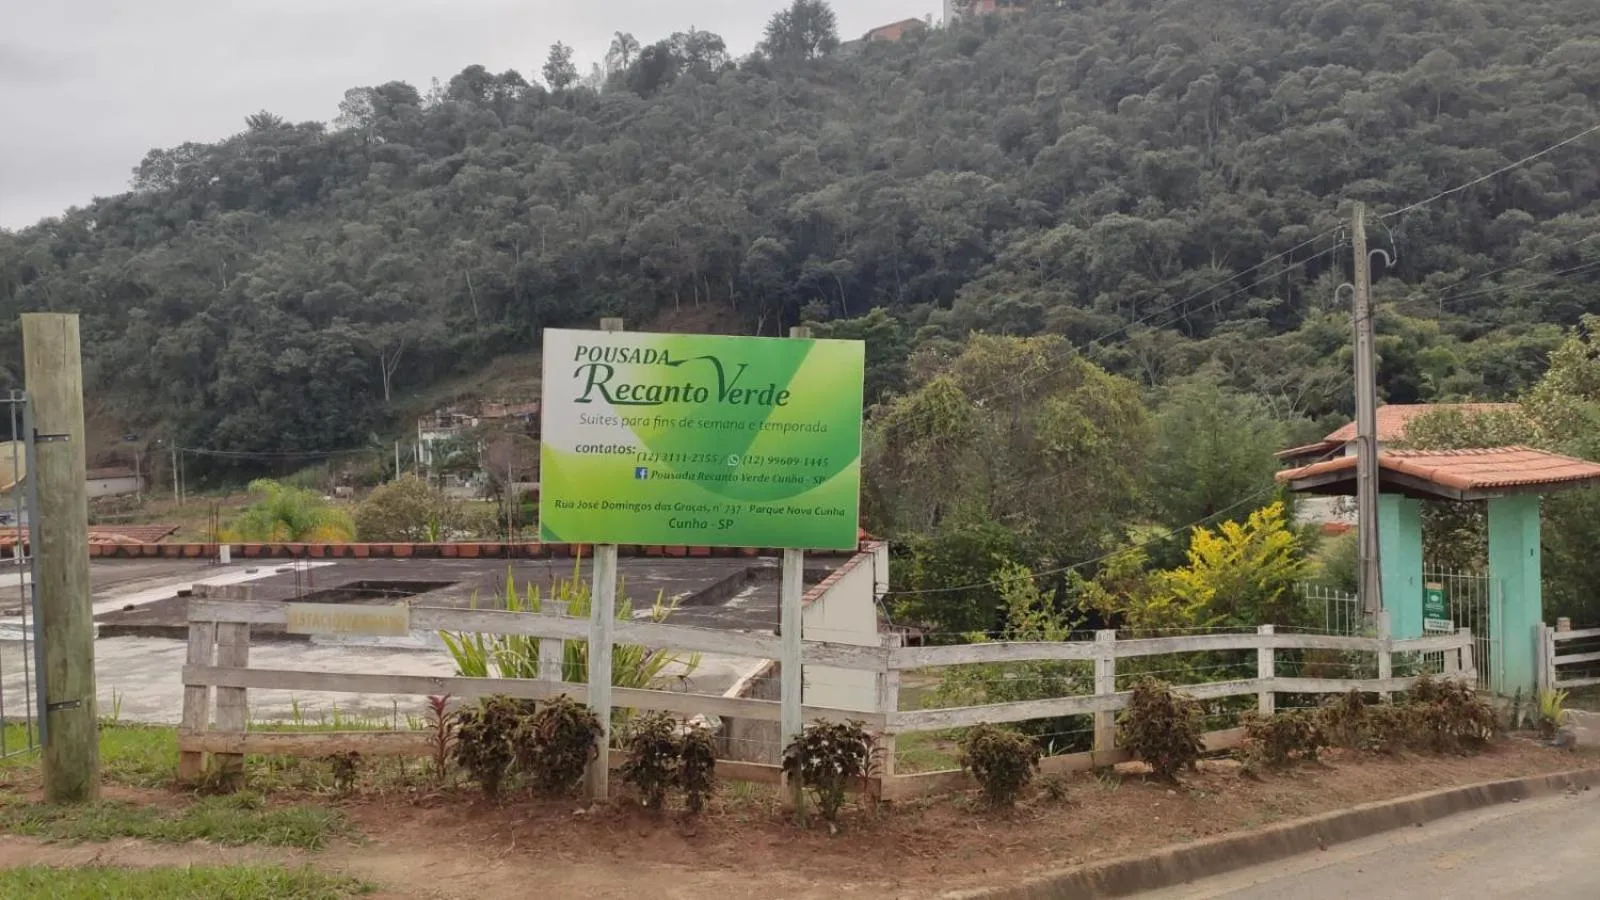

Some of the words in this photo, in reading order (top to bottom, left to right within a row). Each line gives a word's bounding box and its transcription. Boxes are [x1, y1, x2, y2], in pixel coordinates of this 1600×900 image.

[574, 344, 688, 366] POUSADA
[573, 363, 709, 405] Recanto
[693, 355, 791, 407] Verde
[621, 415, 650, 429] para
[653, 415, 677, 429] fins
[678, 418, 692, 429] de
[697, 419, 745, 431] semana
[748, 421, 757, 431] e
[760, 419, 828, 434] temporada
[575, 443, 637, 455] contatos:
[636, 451, 659, 463] (12)
[742, 455, 765, 467] (12)
[650, 470, 696, 481] Pousada
[554, 499, 575, 509] Rua
[601, 499, 652, 513] Domingos
[654, 501, 672, 511] das
[750, 504, 784, 516] Parque
[787, 505, 812, 516] Nova
[814, 506, 845, 516] Cunha
[669, 517, 708, 529] Cunha
[717, 519, 734, 530] SP
